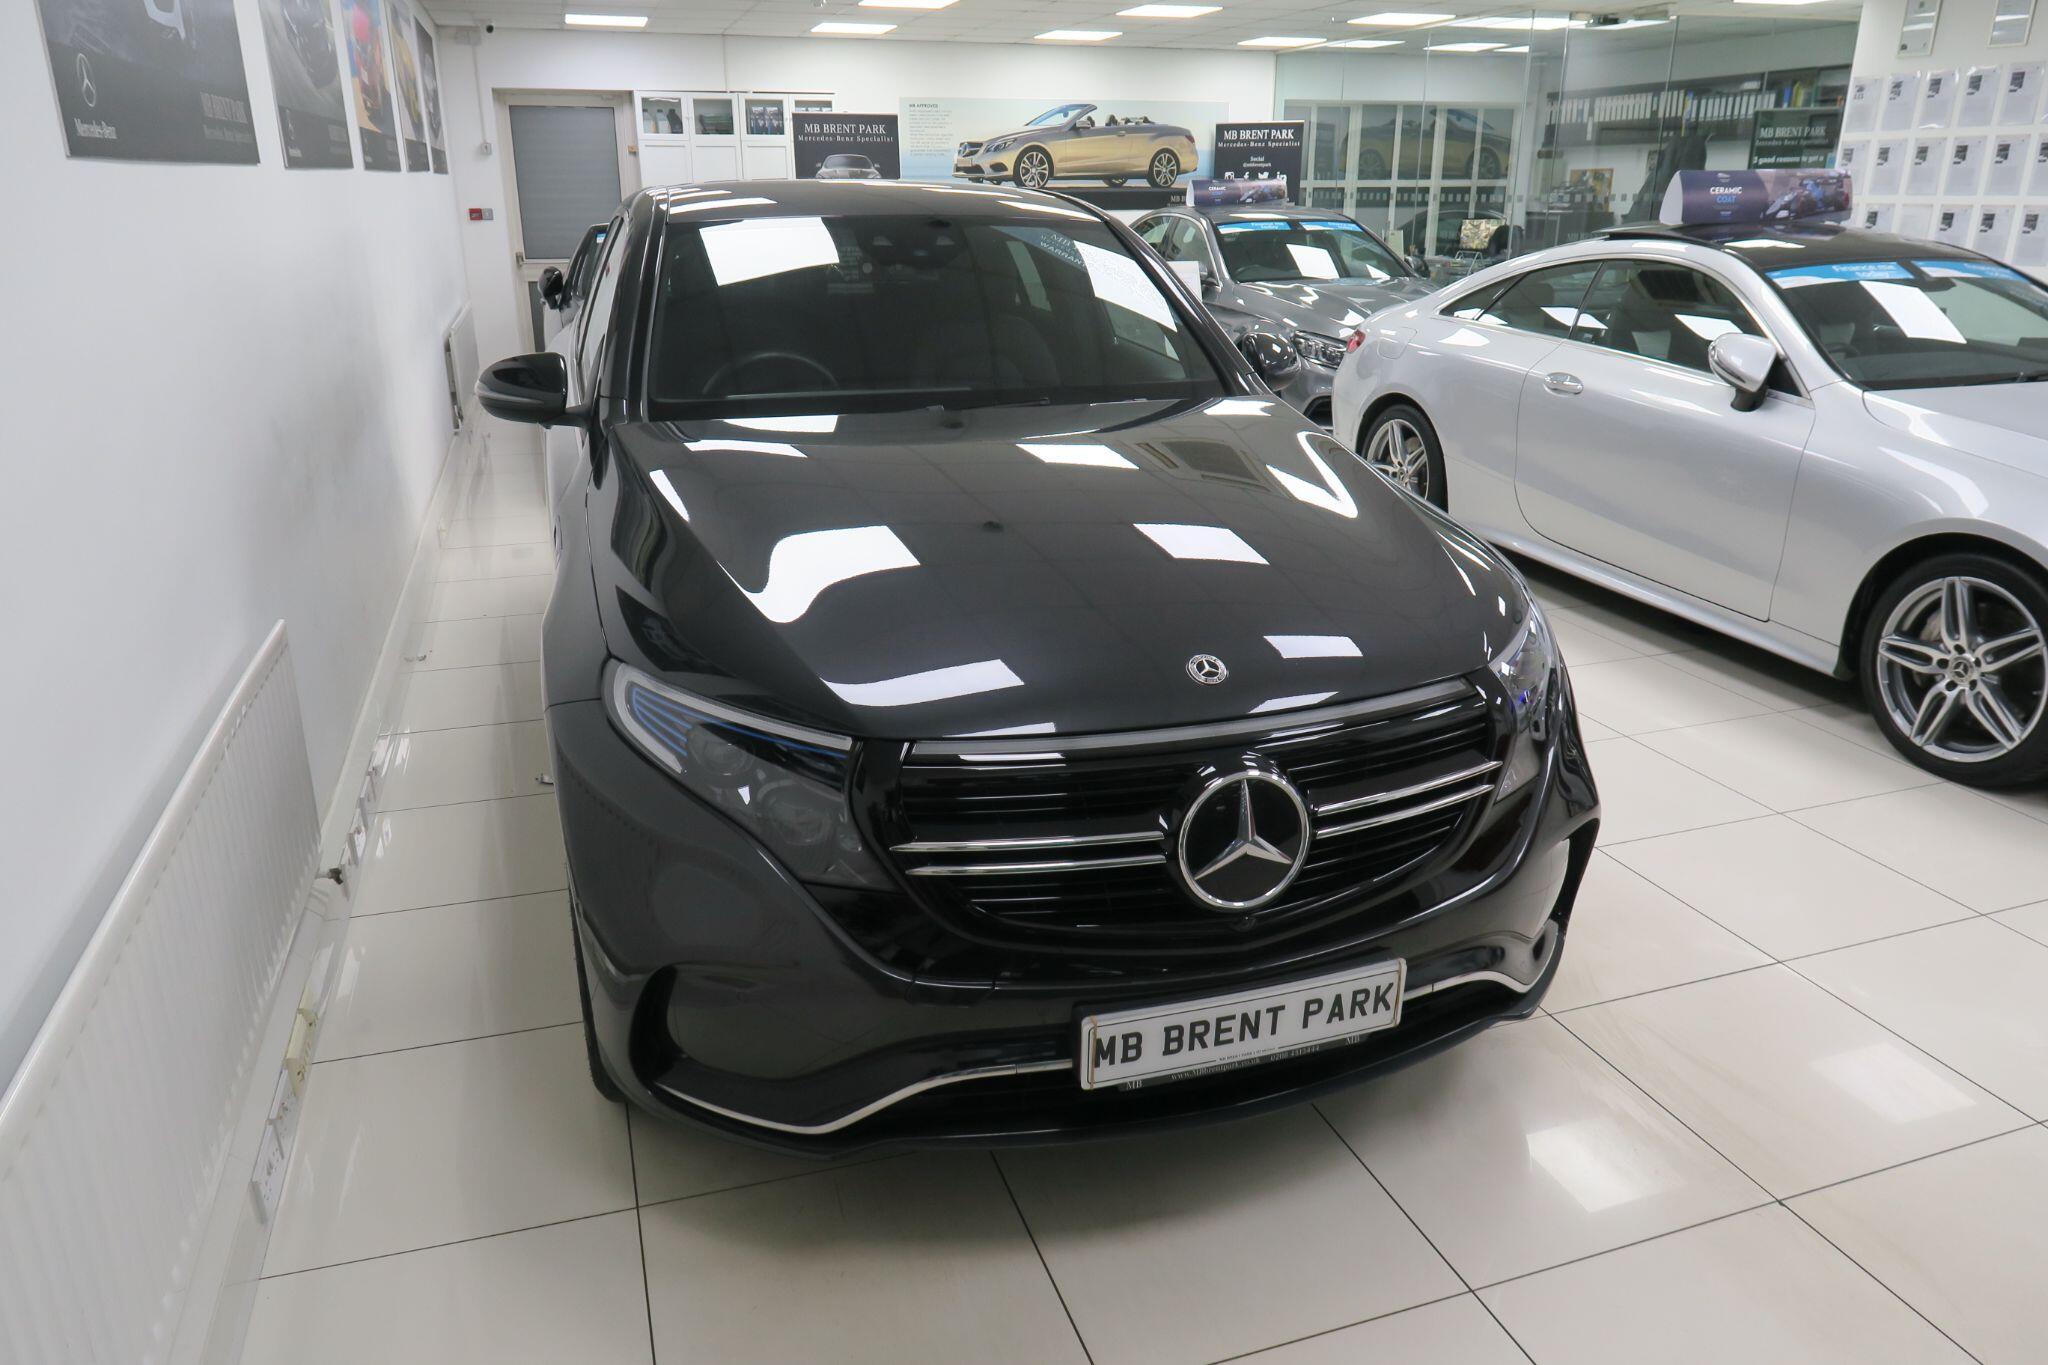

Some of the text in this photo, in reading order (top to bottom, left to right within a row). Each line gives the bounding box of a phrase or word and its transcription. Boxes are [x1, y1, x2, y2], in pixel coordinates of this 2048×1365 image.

[804, 123, 886, 134] MB BRENT PARK
[1760, 126, 1826, 138] MB BRENT PARK
[1224, 129, 1294, 140] MB BRENT PARK
[1710, 186, 1742, 194] CERAMIC
[1716, 195, 1737, 203] COAT
[1095, 982, 1394, 1068] MB BRENT PARK
[1126, 1080, 1142, 1090] MB
